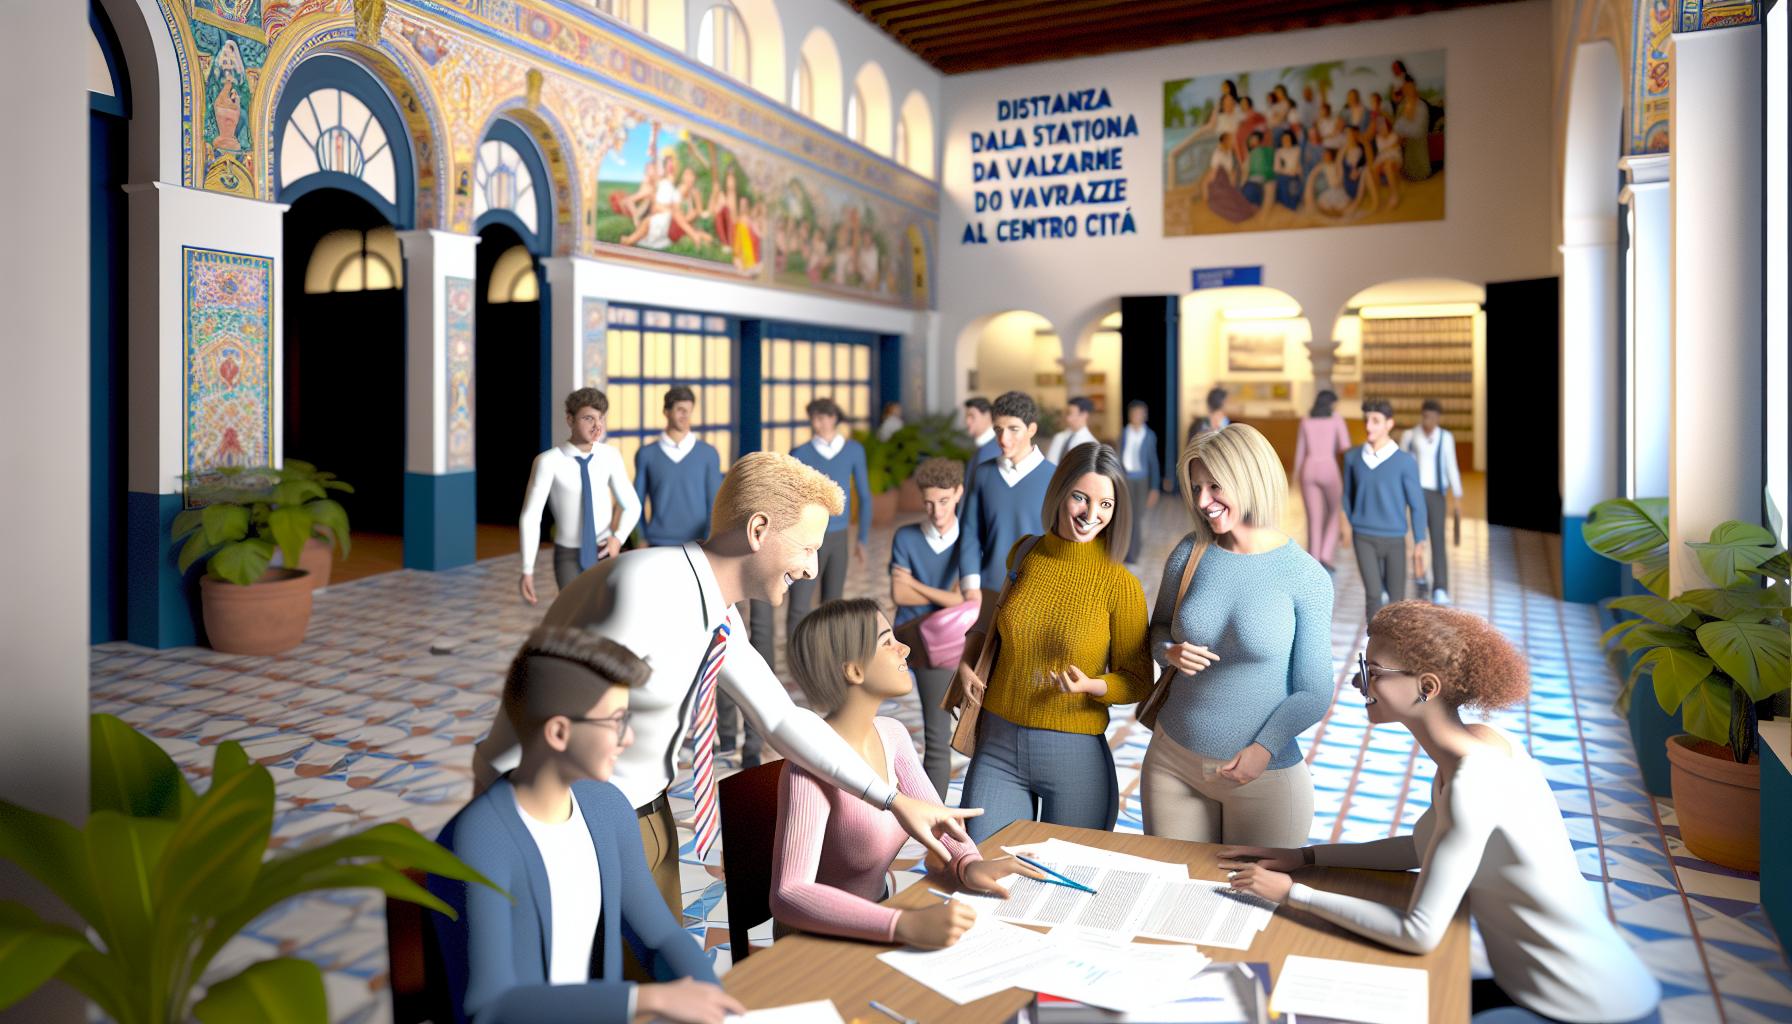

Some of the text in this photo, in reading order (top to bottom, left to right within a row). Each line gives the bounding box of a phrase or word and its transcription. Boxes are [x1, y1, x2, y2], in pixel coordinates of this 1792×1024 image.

[971, 114, 1139, 153] DALA STATIONA
[973, 161, 1000, 182] DA
[975, 190, 1002, 213] DO
[962, 222, 988, 245] AL
[997, 216, 1077, 242] CENTRO
